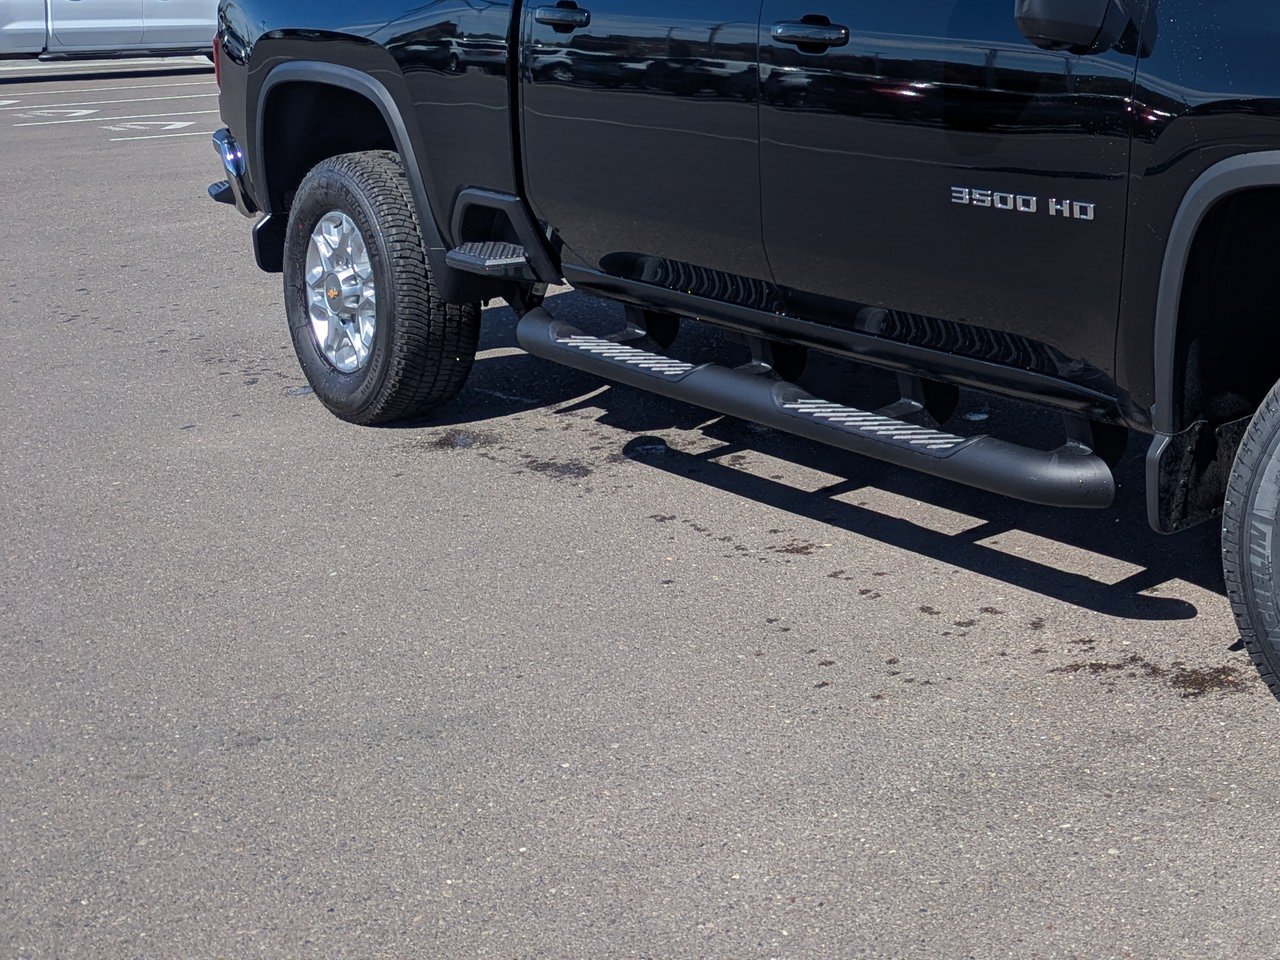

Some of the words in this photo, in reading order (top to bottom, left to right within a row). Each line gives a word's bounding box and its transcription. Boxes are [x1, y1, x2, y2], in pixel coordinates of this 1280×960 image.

[346, 192, 379, 256] MICHELIN
[951, 186, 1037, 212] 3500
[1048, 198, 1096, 220] HD
